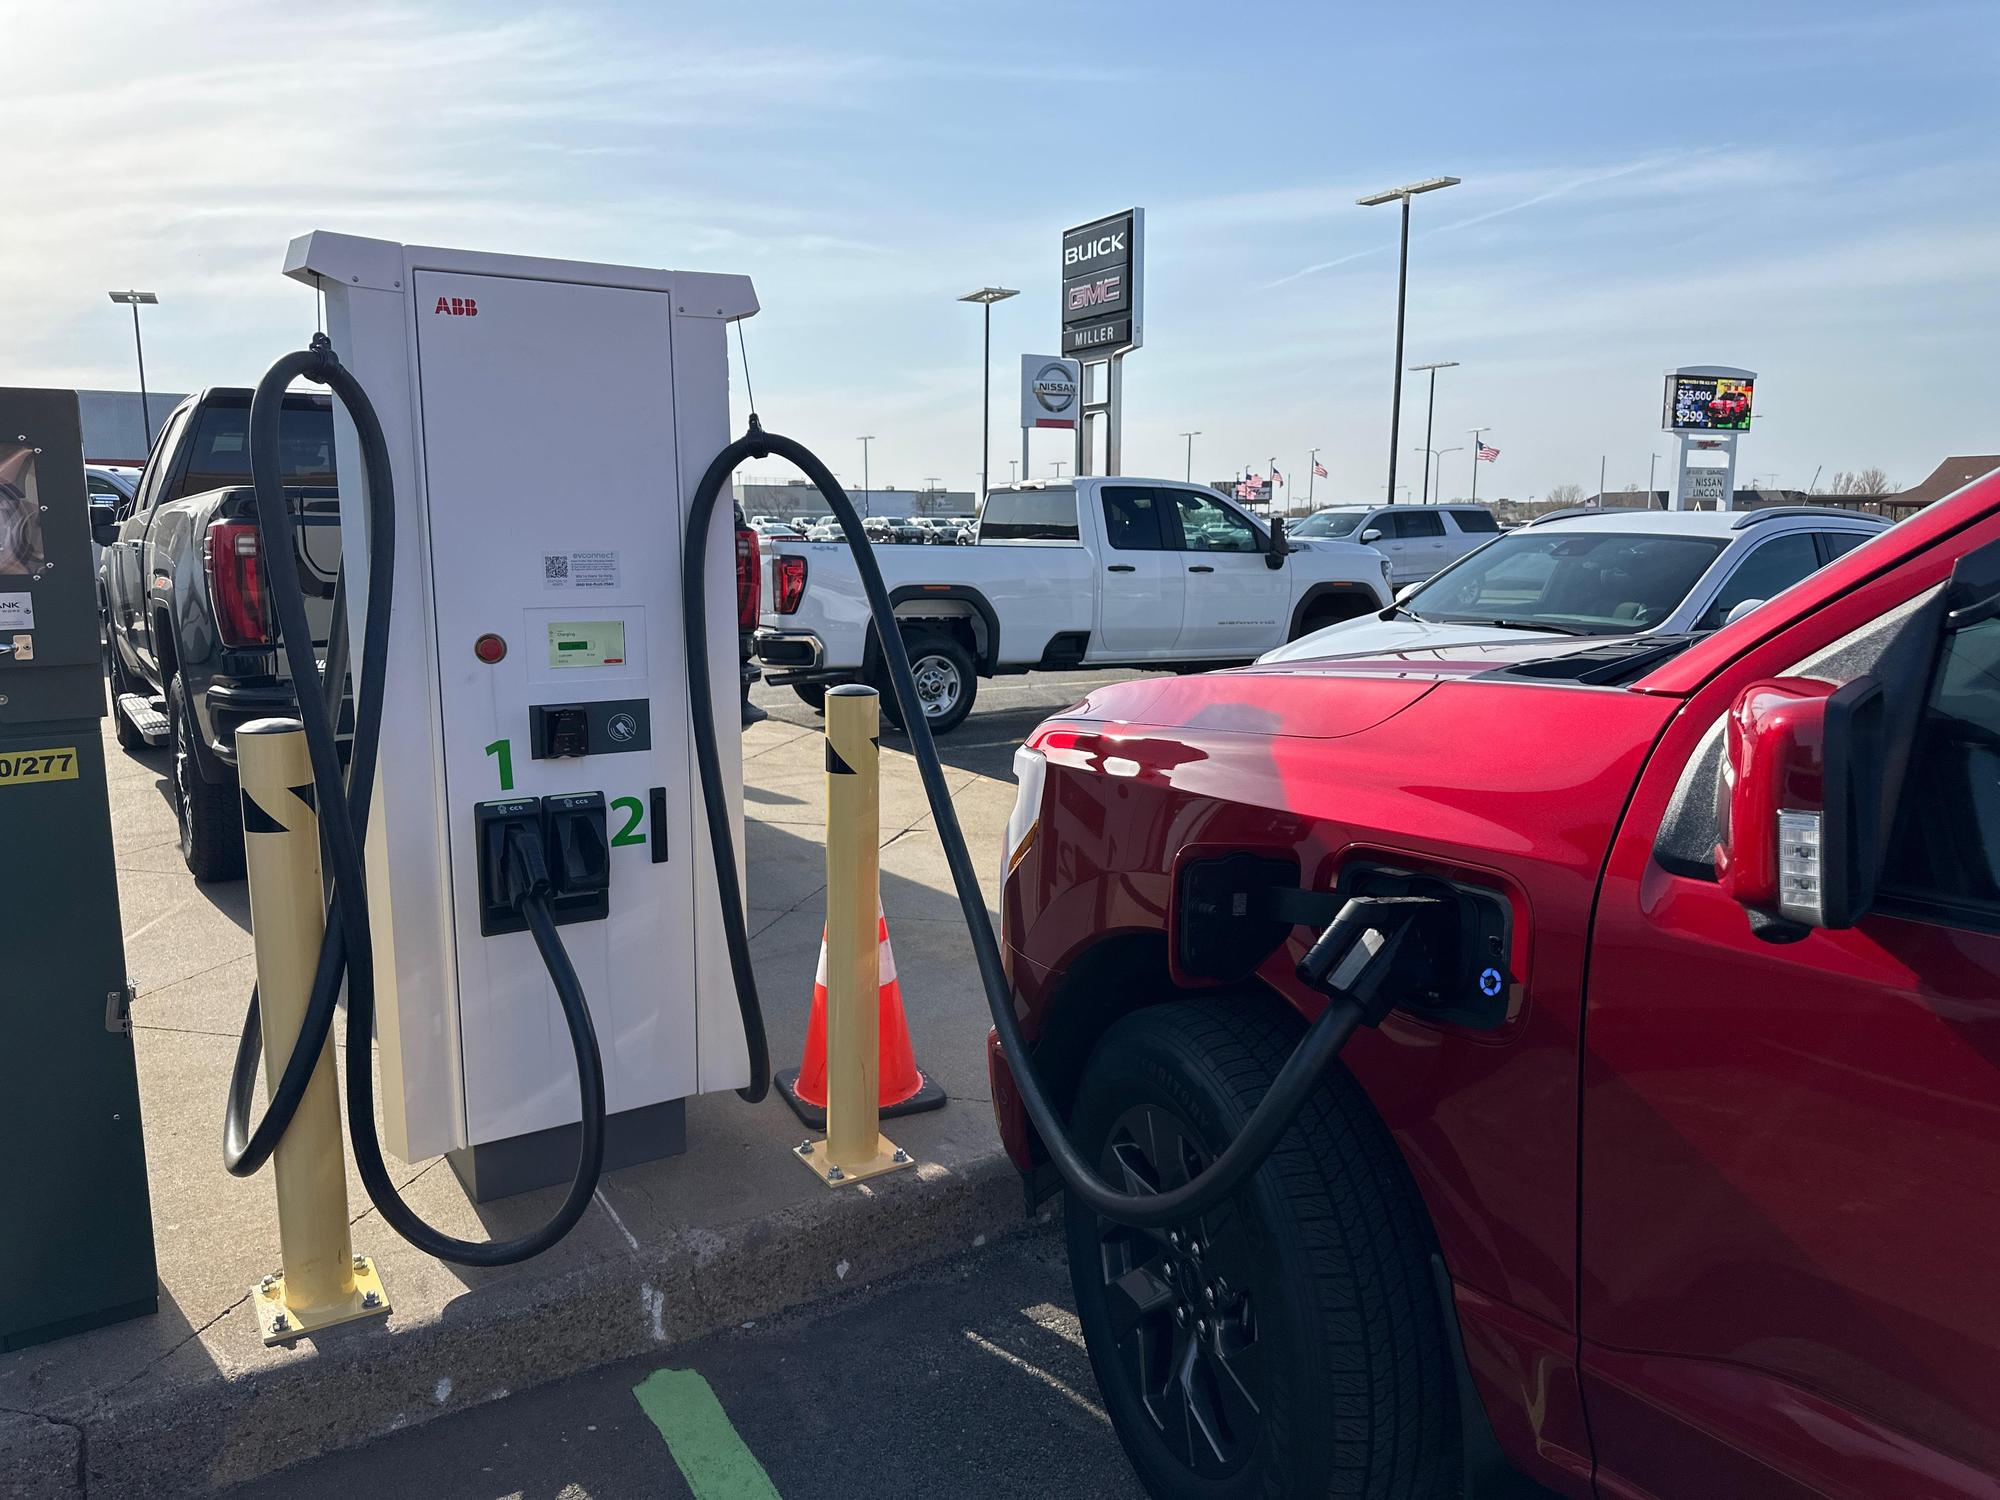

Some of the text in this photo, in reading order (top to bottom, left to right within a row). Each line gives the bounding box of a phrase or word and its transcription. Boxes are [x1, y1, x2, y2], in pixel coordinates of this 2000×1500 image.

[1065, 232, 1125, 265] BUICK
[1069, 276, 1120, 310] GMC
[435, 296, 478, 317] ABB
[1075, 326, 1114, 346] MILLER
[1039, 382, 1076, 393] NISSAN
[1676, 410, 1703, 422] $299
[1696, 478, 1722, 487] NISSAN
[1693, 489, 1724, 497] LINCOLN
[485, 739, 514, 791] 1
[610, 796, 646, 847] 2
